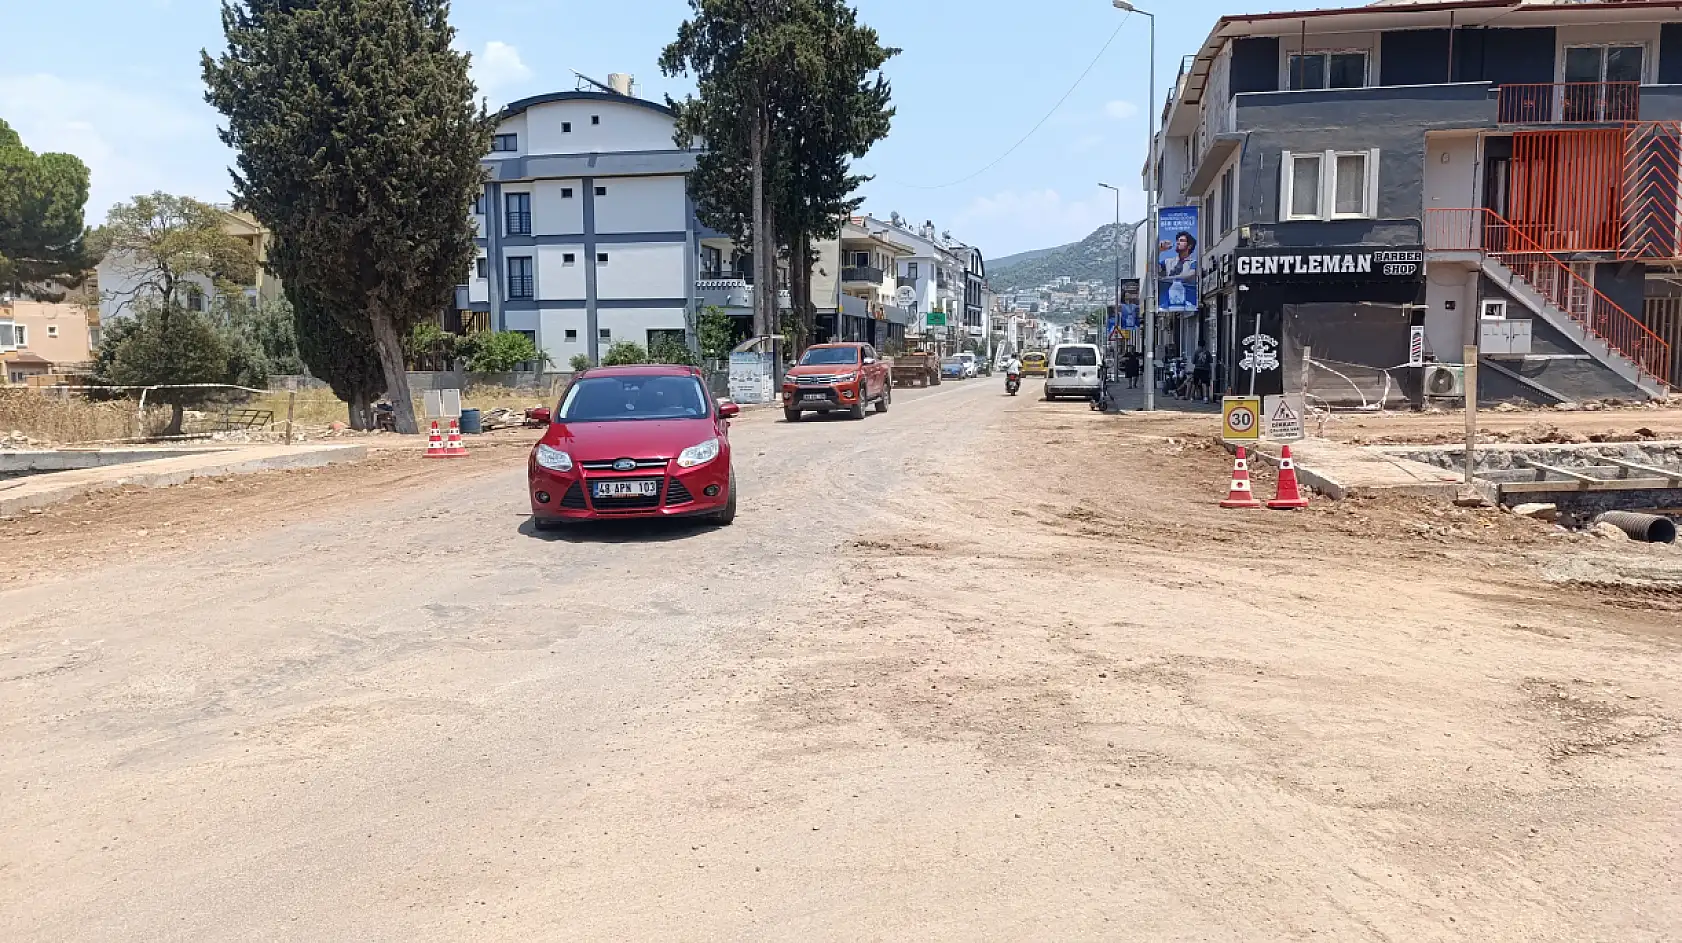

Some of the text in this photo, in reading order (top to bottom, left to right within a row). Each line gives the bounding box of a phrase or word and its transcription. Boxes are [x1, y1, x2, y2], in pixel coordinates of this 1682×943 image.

[1374, 251, 1423, 262] BARBER
[1237, 254, 1372, 275] GENTLEMAN
[1383, 264, 1416, 275] SHOP
[1231, 413, 1251, 426] 30
[599, 483, 610, 494] 48
[639, 482, 656, 492] 103
